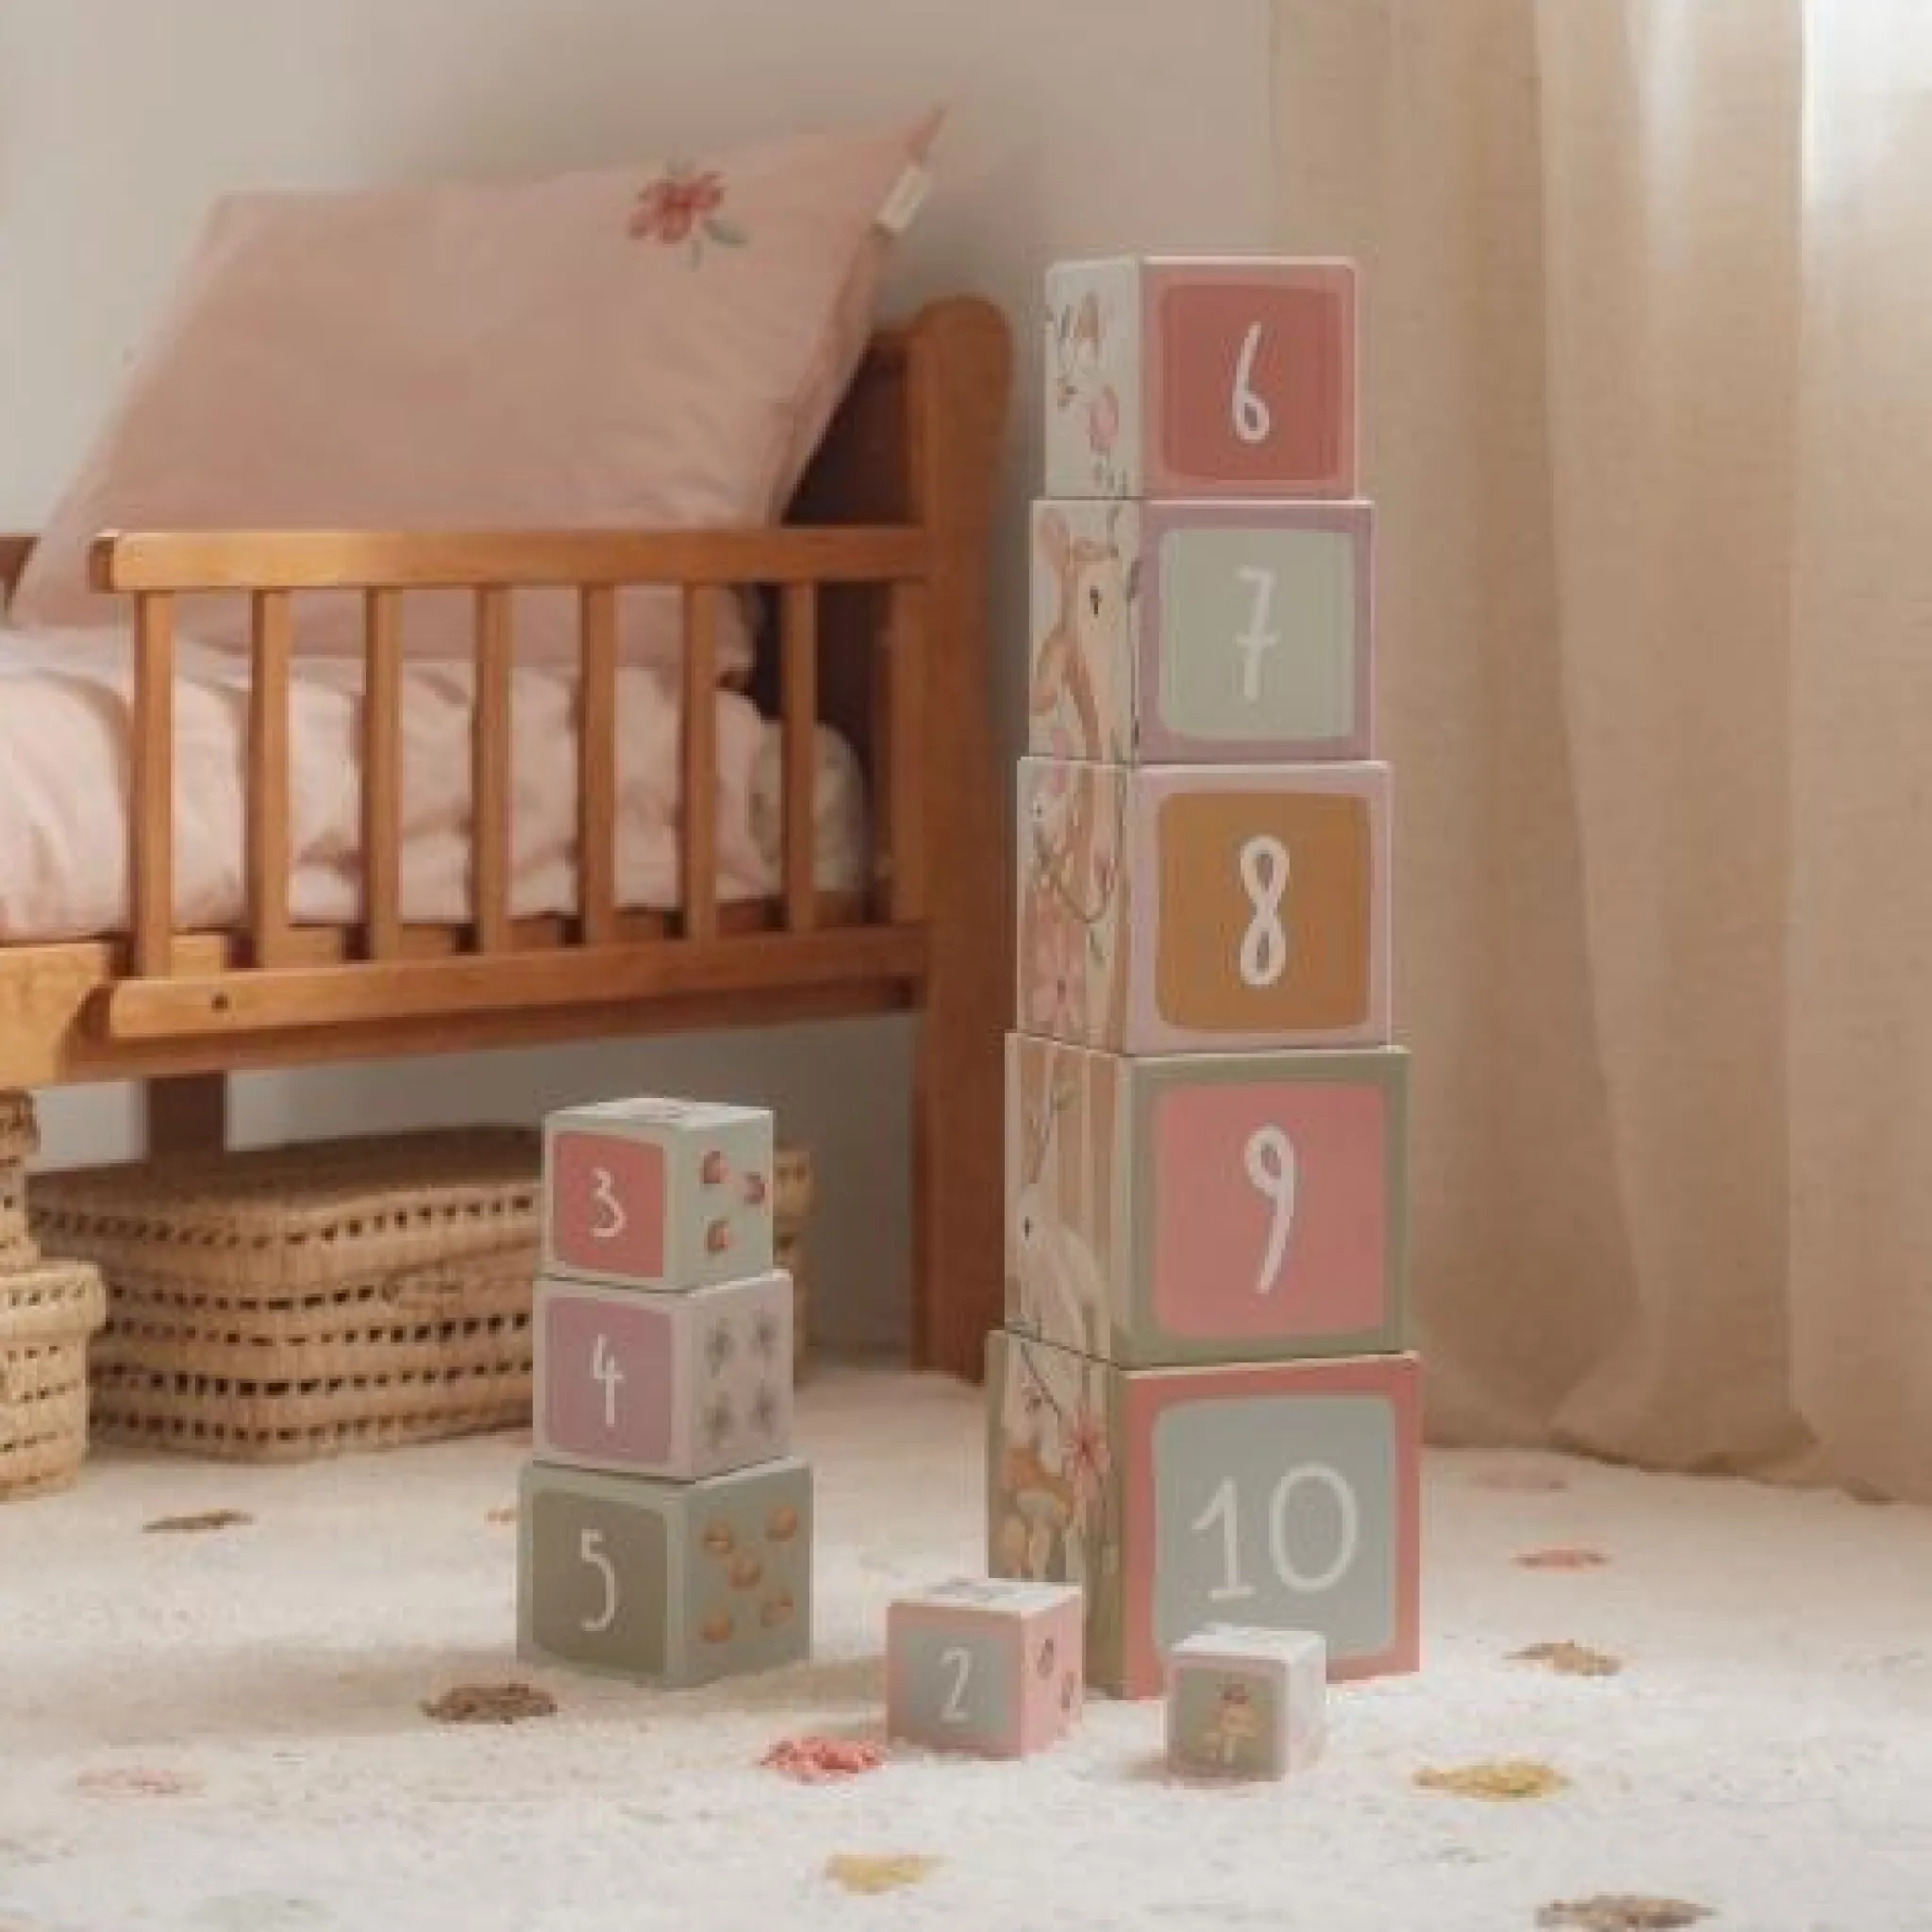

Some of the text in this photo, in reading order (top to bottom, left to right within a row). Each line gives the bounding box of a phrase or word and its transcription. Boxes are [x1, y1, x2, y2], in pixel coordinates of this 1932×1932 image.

[1233, 322, 1270, 441] 6
[1233, 566, 1279, 703] 7
[1238, 835, 1291, 987] 8
[591, 1169, 626, 1237] 3
[1241, 1124, 1299, 1294] 9
[589, 1333, 625, 1426] 4
[578, 1529, 617, 1630] 5
[1191, 1462, 1358, 1600] 10
[940, 1646, 970, 1723] 2
